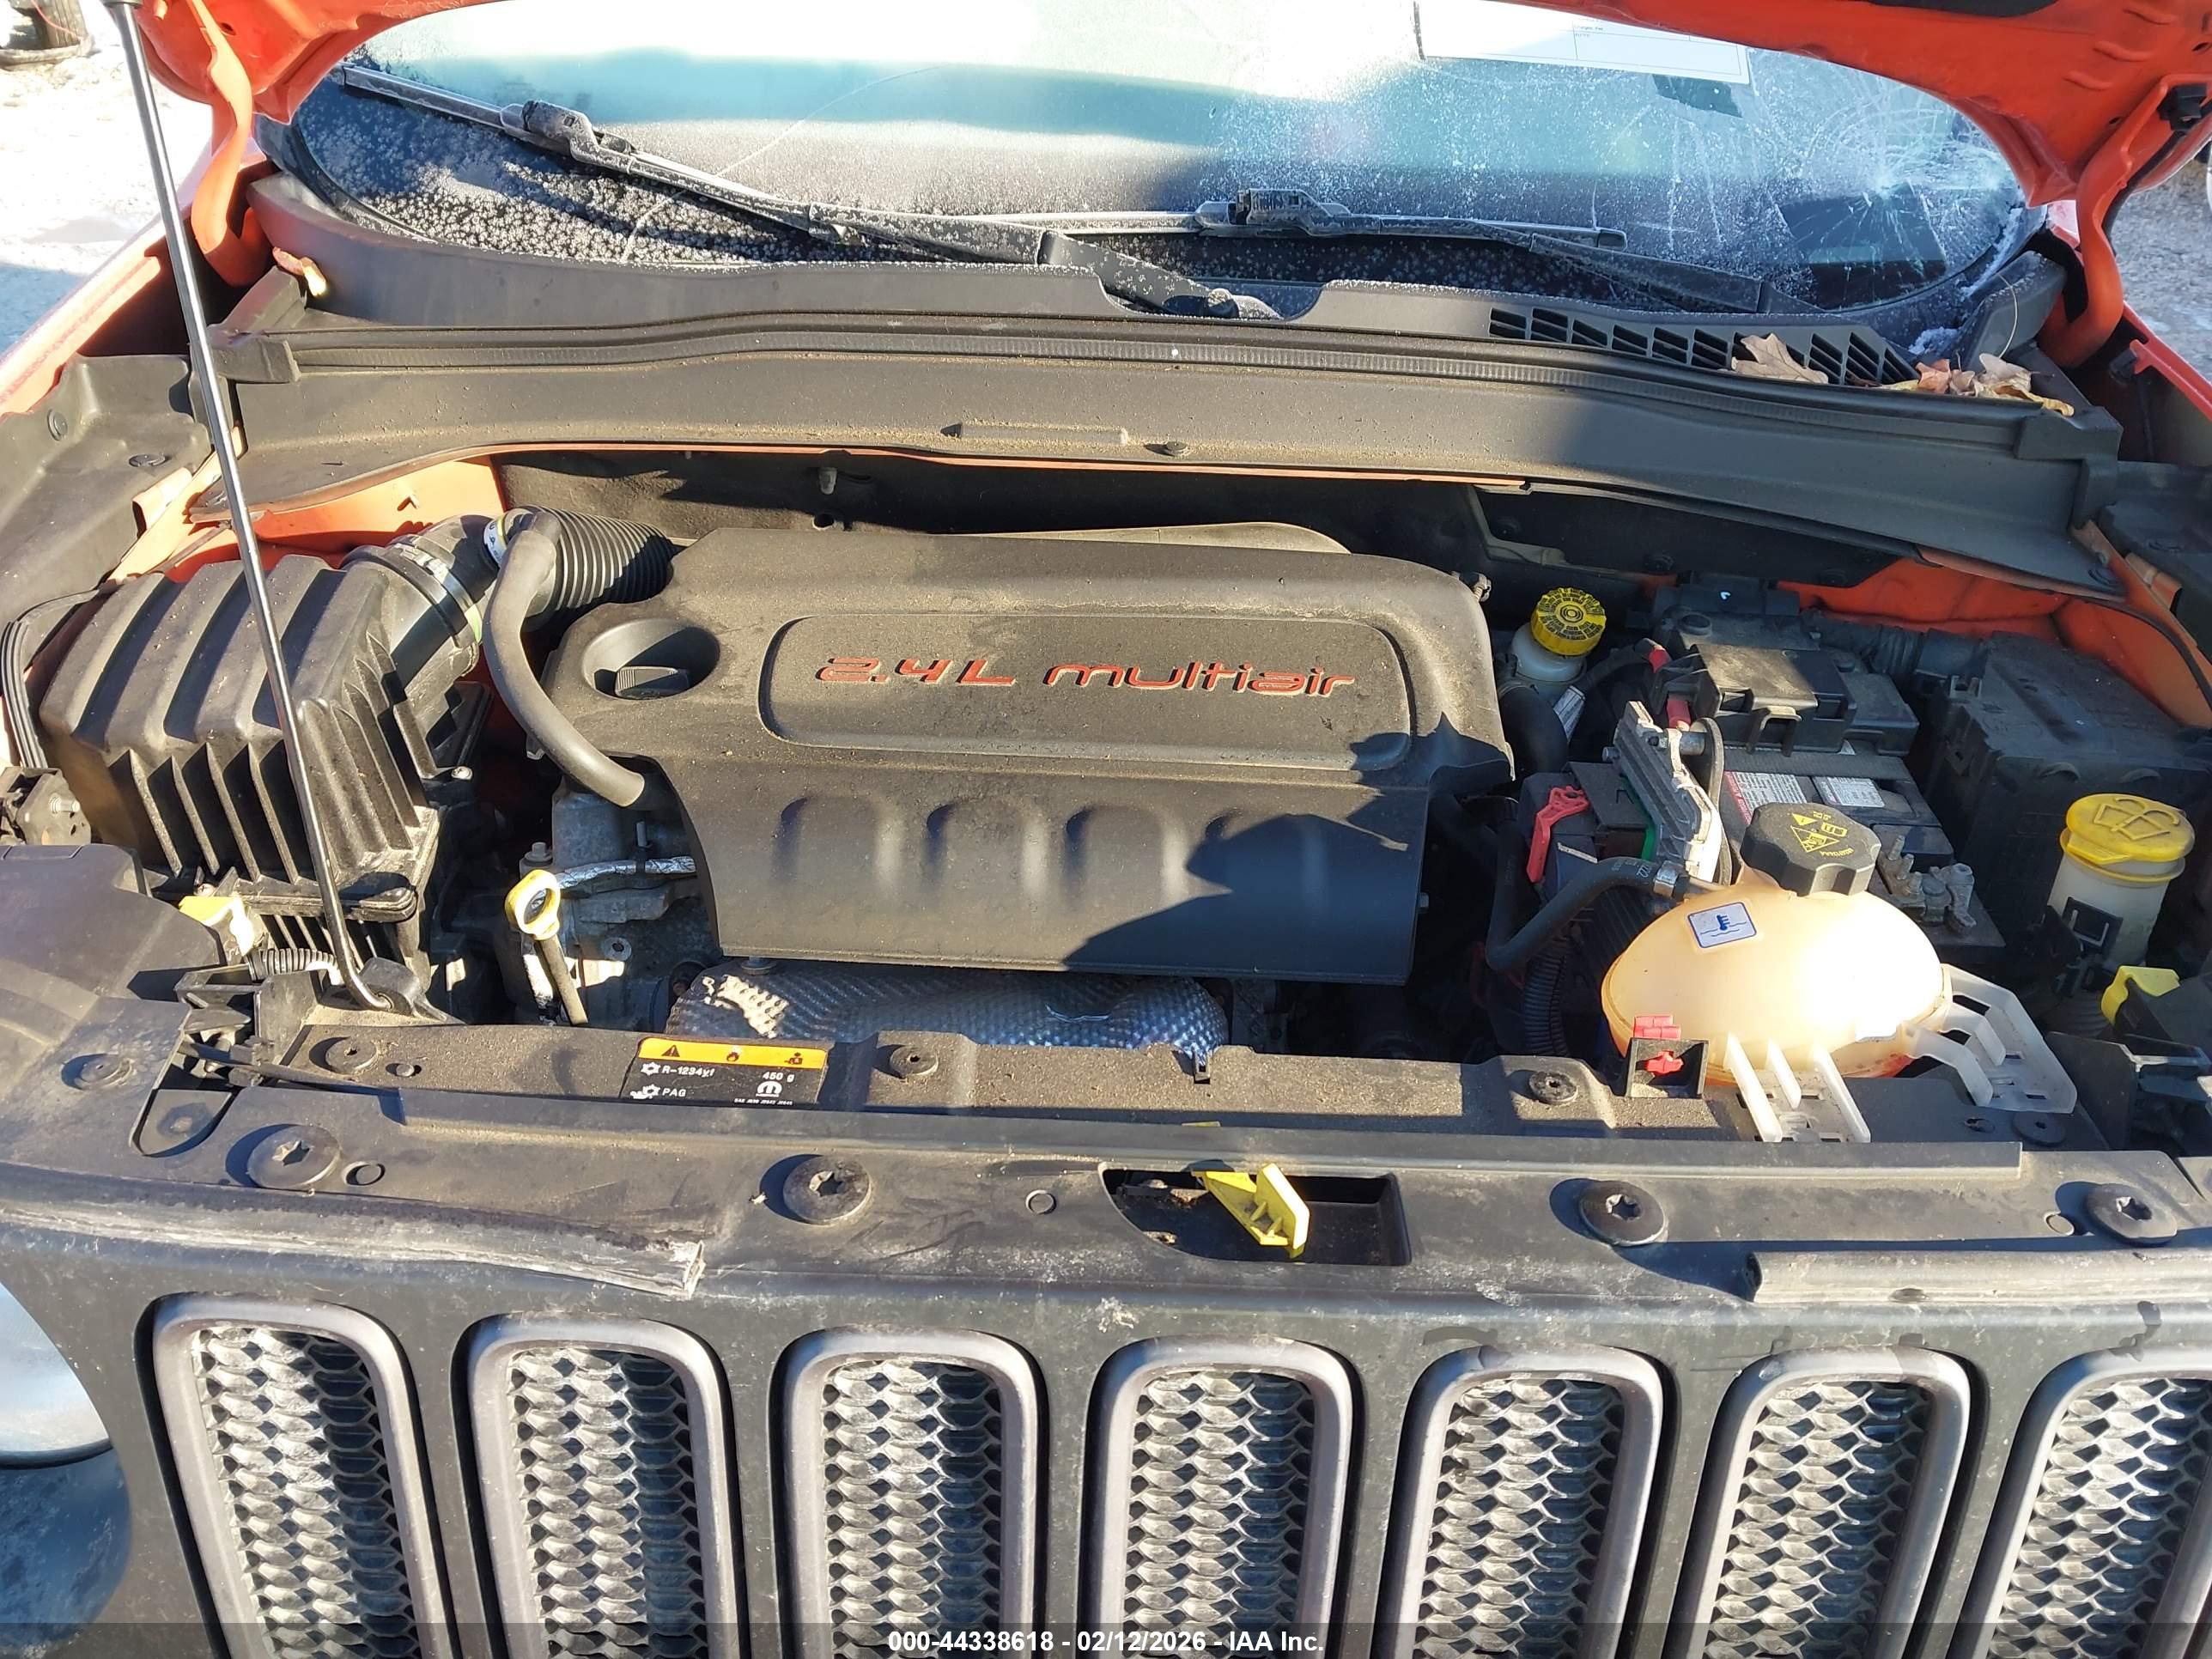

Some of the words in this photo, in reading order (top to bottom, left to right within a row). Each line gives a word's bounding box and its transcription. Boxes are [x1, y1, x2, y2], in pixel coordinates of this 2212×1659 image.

[1043, 660, 1354, 696] multiair
[661, 1065, 715, 1078] R-1234yf
[662, 1087, 687, 1097] PAG
